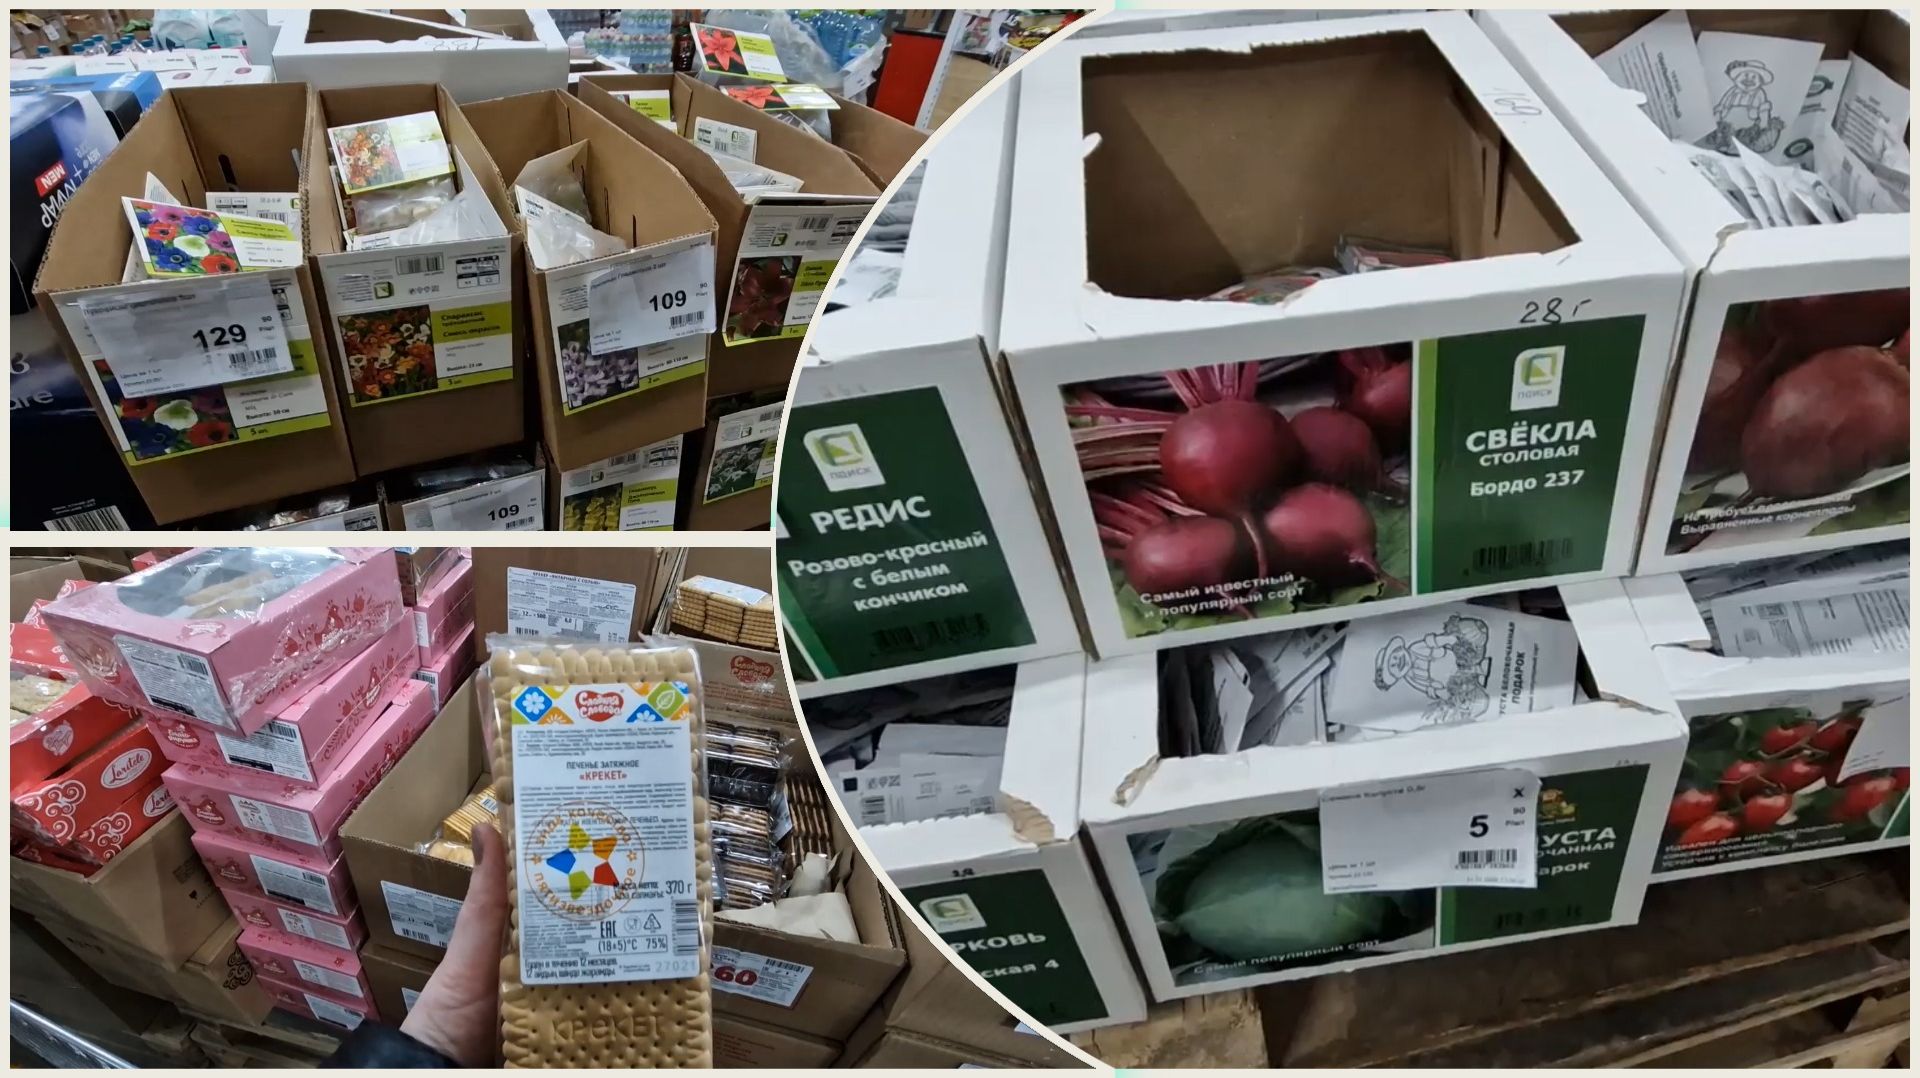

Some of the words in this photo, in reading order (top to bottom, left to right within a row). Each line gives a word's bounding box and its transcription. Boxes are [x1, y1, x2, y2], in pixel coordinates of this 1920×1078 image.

[41, 163, 65, 189] MEN
[649, 289, 687, 312] 109
[1520, 298, 1563, 324] 28
[193, 324, 247, 350] 129
[1465, 419, 1598, 453] СВЁКЛА
[1479, 444, 1580, 467] СТОЛОВАЯ
[1469, 475, 1538, 497] Бордо
[1543, 469, 1586, 489] 237
[488, 504, 520, 521] 109
[810, 495, 932, 535] РЕДИС
[787, 531, 989, 578] Розово-красный
[852, 576, 867, 590] с
[871, 562, 951, 587] белым
[1139, 586, 1200, 604] Самый
[1204, 572, 1295, 594] известный
[853, 582, 969, 612] кончиком
[1144, 610, 1155, 619] и
[1159, 592, 1263, 617] популярный
[1267, 586, 1305, 601] сорт
[1511, 651, 1526, 705] ПОДАРОК
[566, 760, 599, 770] ПЕЧЕНЬЕ
[600, 759, 640, 769] ЗАТЯЖНОЕ
[579, 770, 628, 781] «КРЕКЕТ»
[1513, 806, 1526, 815] 90
[1469, 814, 1490, 838] 5
[1541, 827, 1617, 848] УСТА
[1537, 841, 1615, 858] ОЧАННАЯ
[1538, 862, 1591, 876] арок
[665, 879, 685, 895] 370
[645, 937, 667, 950] 75%
[949, 932, 1047, 954] РКОВЬ
[1194, 959, 1247, 975] Самый
[1250, 944, 1344, 965] популярный
[1348, 938, 1380, 950] сорт
[979, 962, 1037, 979] ская
[1044, 959, 1060, 969] 4
